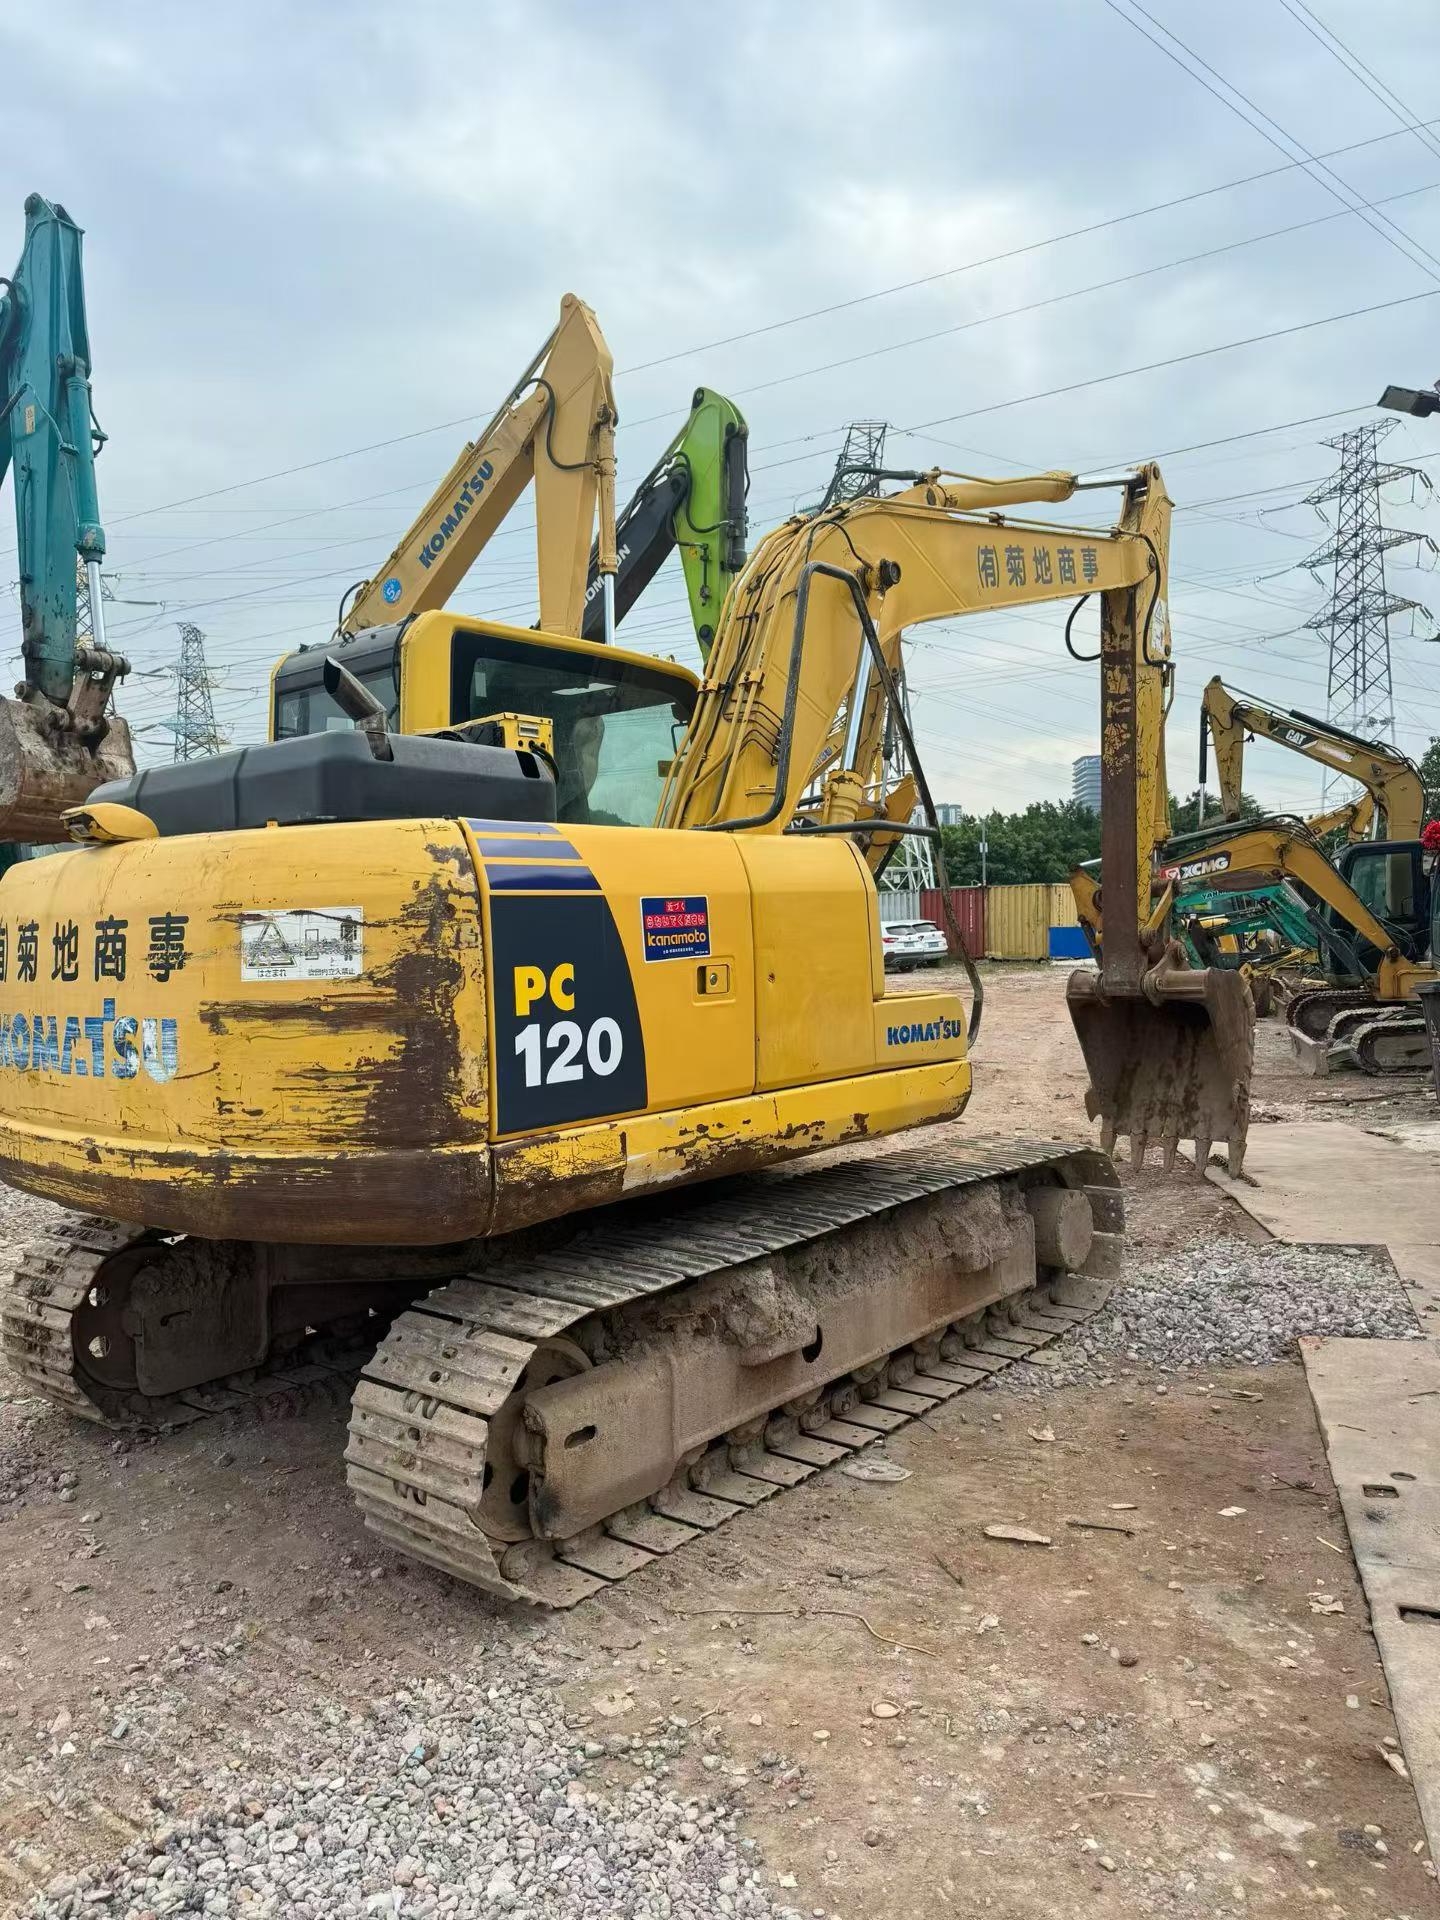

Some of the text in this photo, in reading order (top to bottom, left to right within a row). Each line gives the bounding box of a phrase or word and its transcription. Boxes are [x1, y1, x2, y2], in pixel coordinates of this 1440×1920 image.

[418, 459, 494, 569] KOMATSU
[1285, 729, 1307, 745] CAT
[1180, 856, 1229, 879] XCMG
[647, 929, 706, 946] kanamoto
[514, 963, 575, 1016] PC
[887, 1016, 961, 1046] KOMATSU
[515, 1017, 623, 1088] 120
